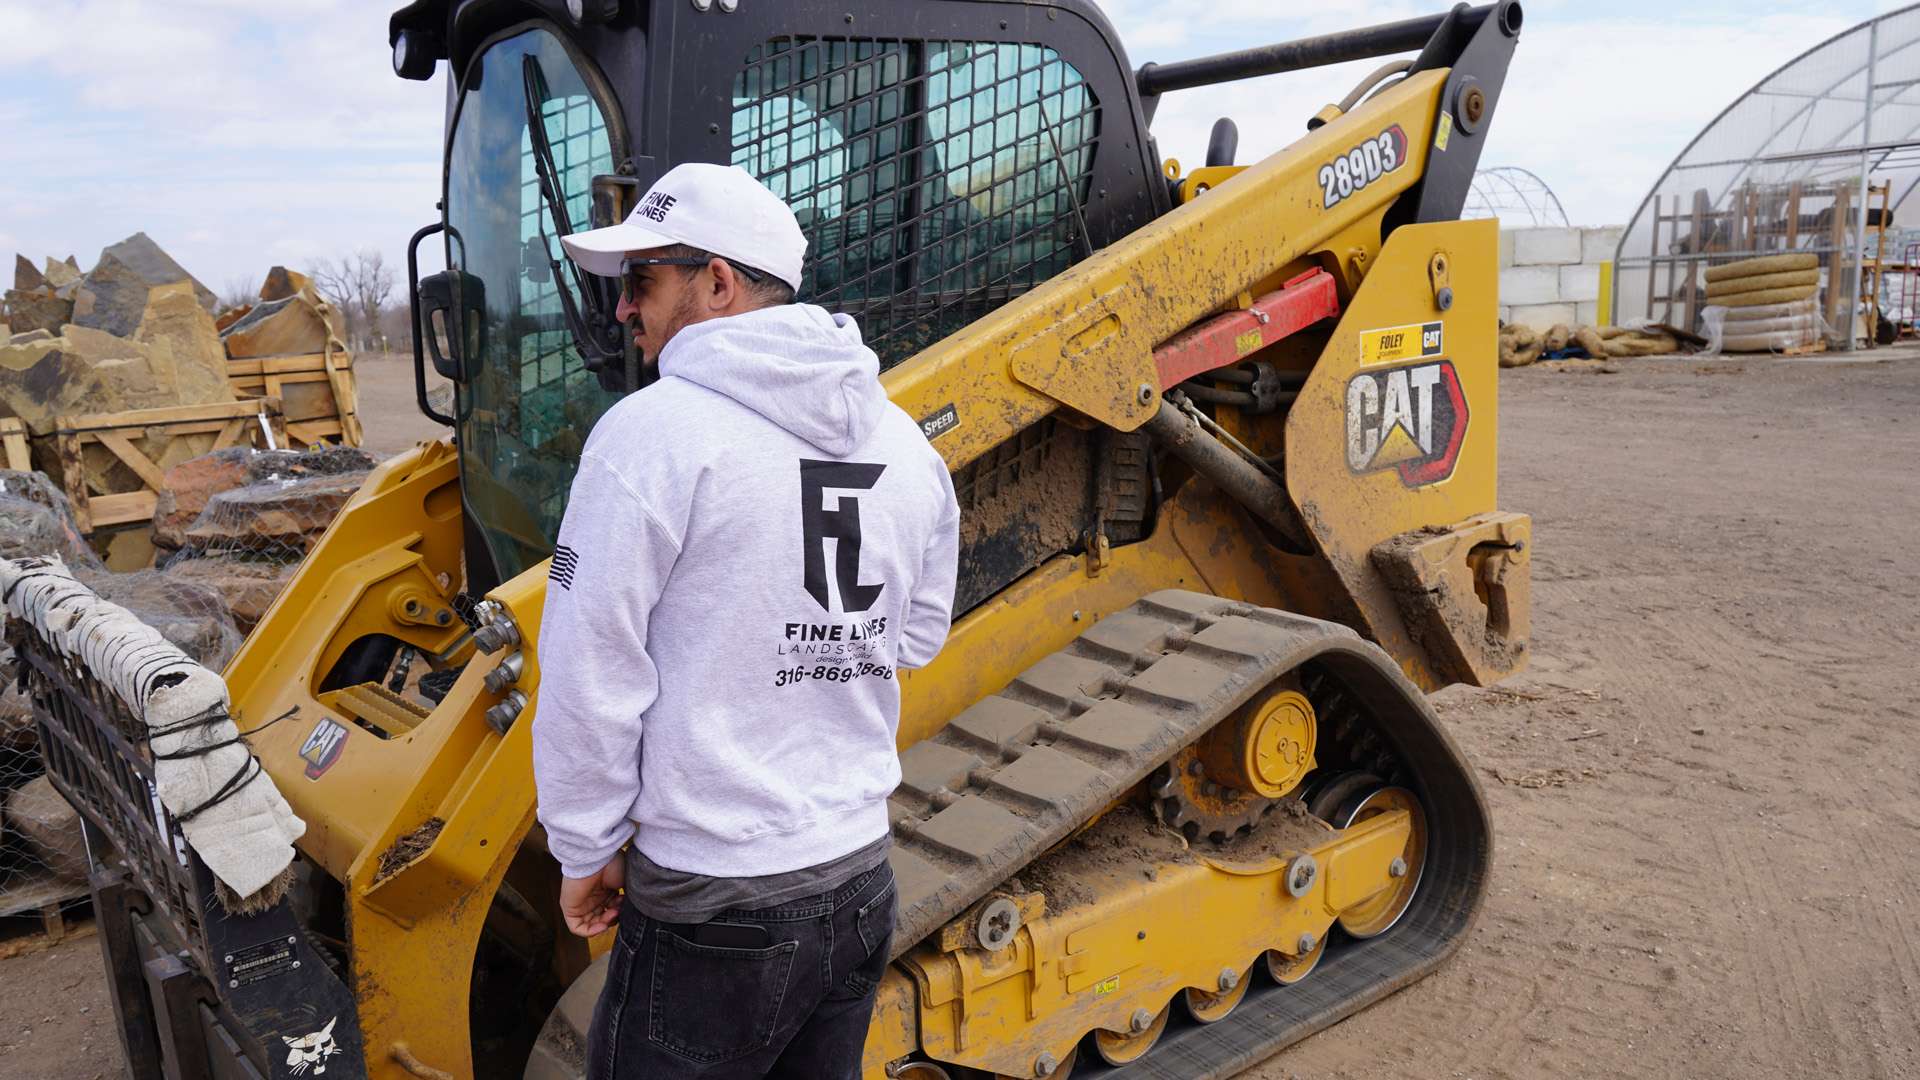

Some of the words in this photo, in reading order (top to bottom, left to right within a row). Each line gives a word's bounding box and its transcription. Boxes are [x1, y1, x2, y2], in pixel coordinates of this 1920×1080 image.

[1318, 130, 1397, 210] 289D3
[636, 204, 666, 223] LINES
[645, 191, 677, 212] FINE
[1380, 333, 1404, 350] FOLEY
[1423, 330, 1440, 348] CAT
[924, 411, 954, 436] SPEED
[1347, 364, 1441, 471] CAT
[785, 622, 843, 641] FINE
[850, 616, 887, 641] LINES
[778, 635, 888, 656] LANDSCAP
[300, 718, 347, 767] CAT
